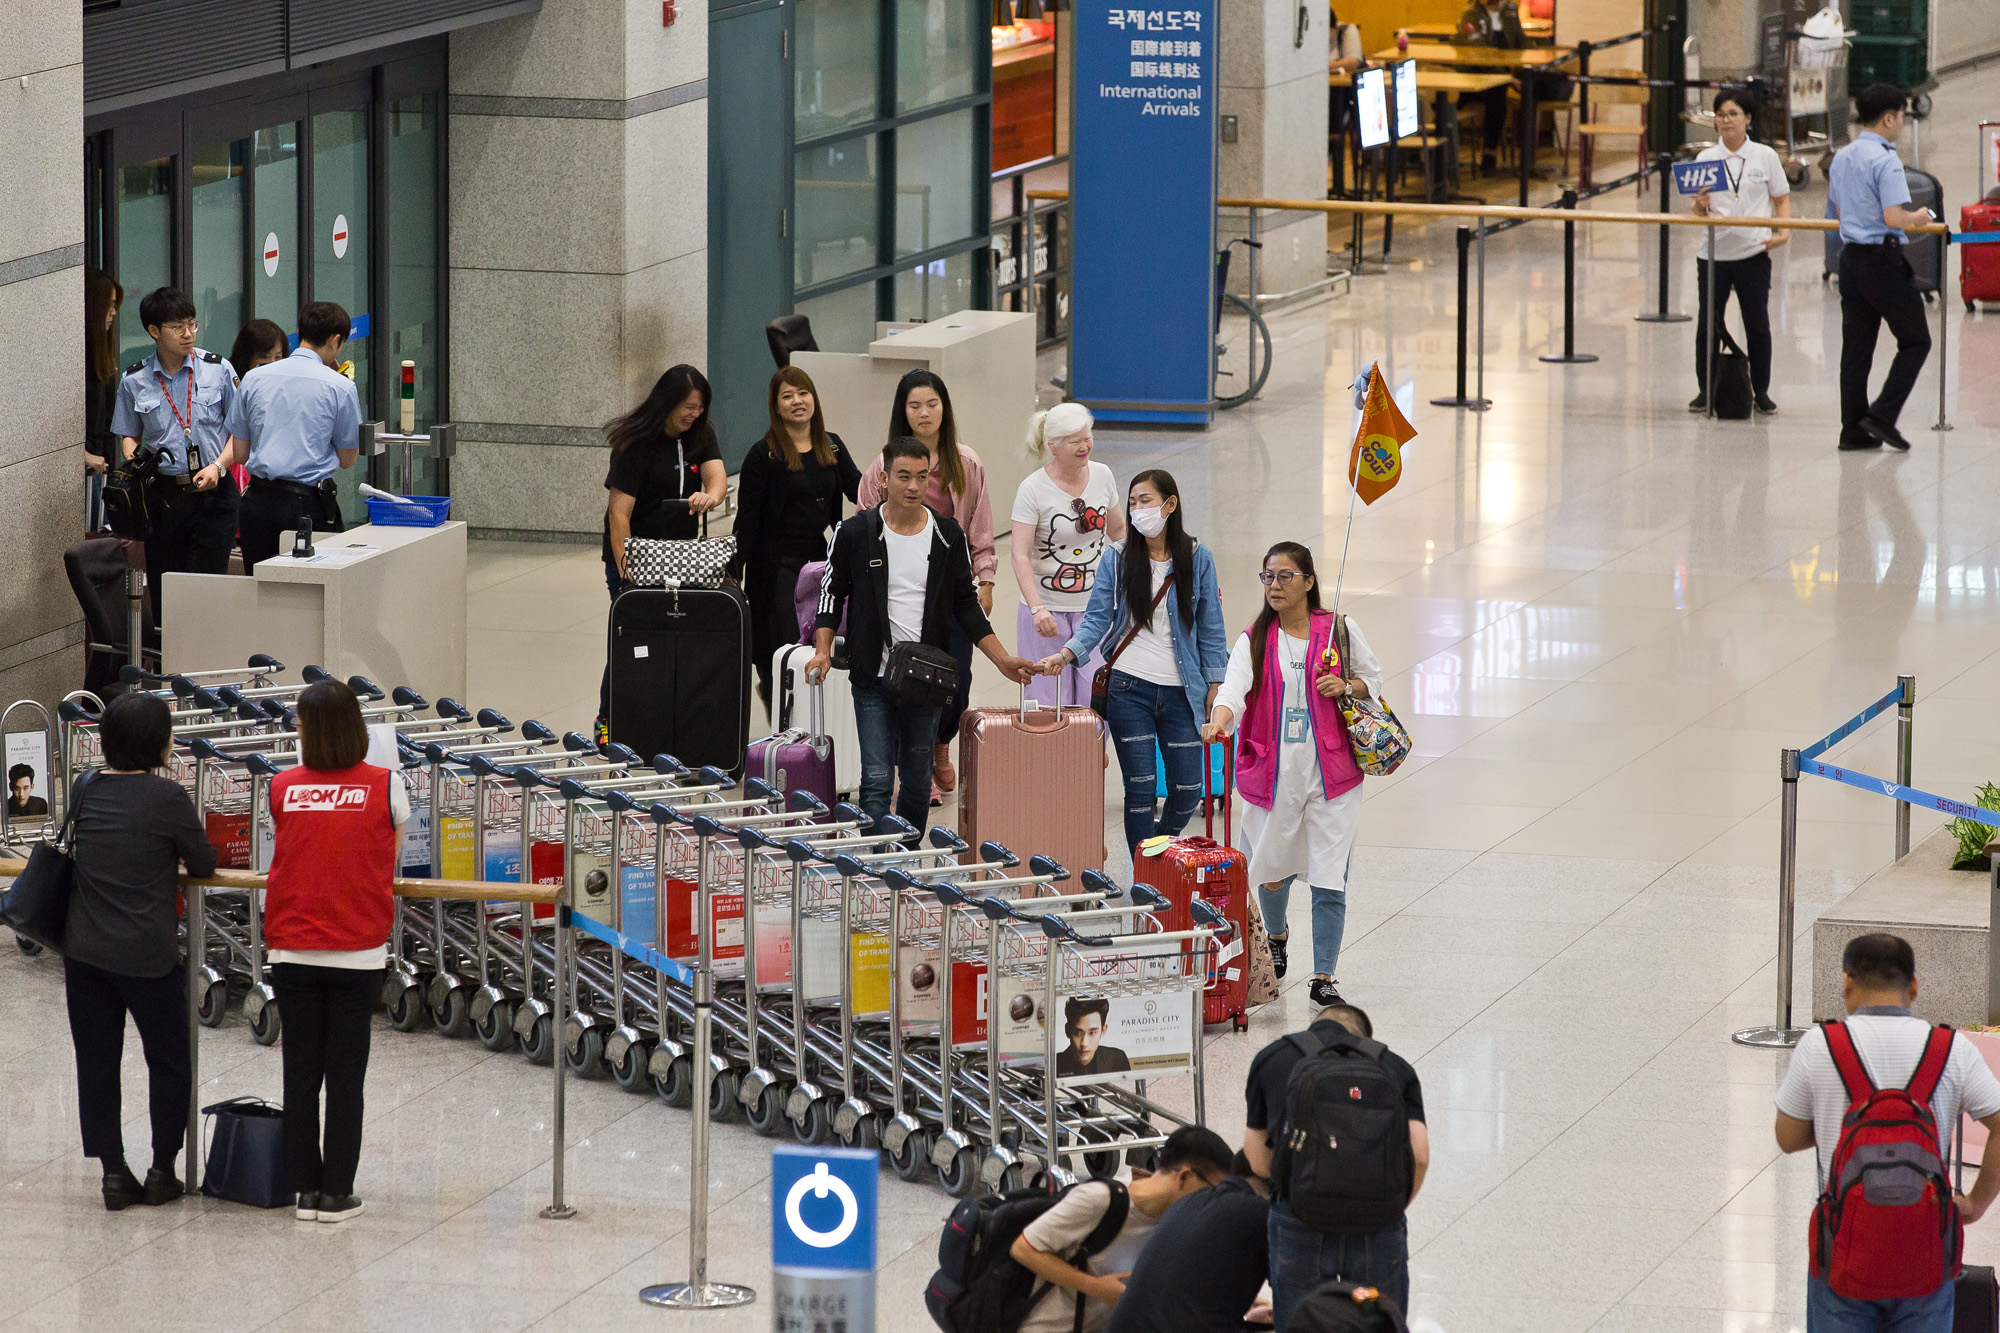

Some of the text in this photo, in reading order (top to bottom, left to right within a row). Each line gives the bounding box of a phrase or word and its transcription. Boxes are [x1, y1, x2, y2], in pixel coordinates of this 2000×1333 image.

[1108, 9, 1202, 31] 국제선도착
[1130, 61, 1201, 78] 国际线到达
[1099, 83, 1202, 99] International
[1141, 101, 1201, 117] Arrivals
[1680, 167, 1719, 188] HIS
[1361, 446, 1387, 476] tour
[1370, 441, 1395, 471] cola
[287, 789, 366, 806] LOOK JTB
[1936, 798, 1978, 819] SECURITY
[858, 938, 875, 946] FIND
[858, 948, 889, 957] OF TRAN
[1121, 1017, 1160, 1027] PARADISE
